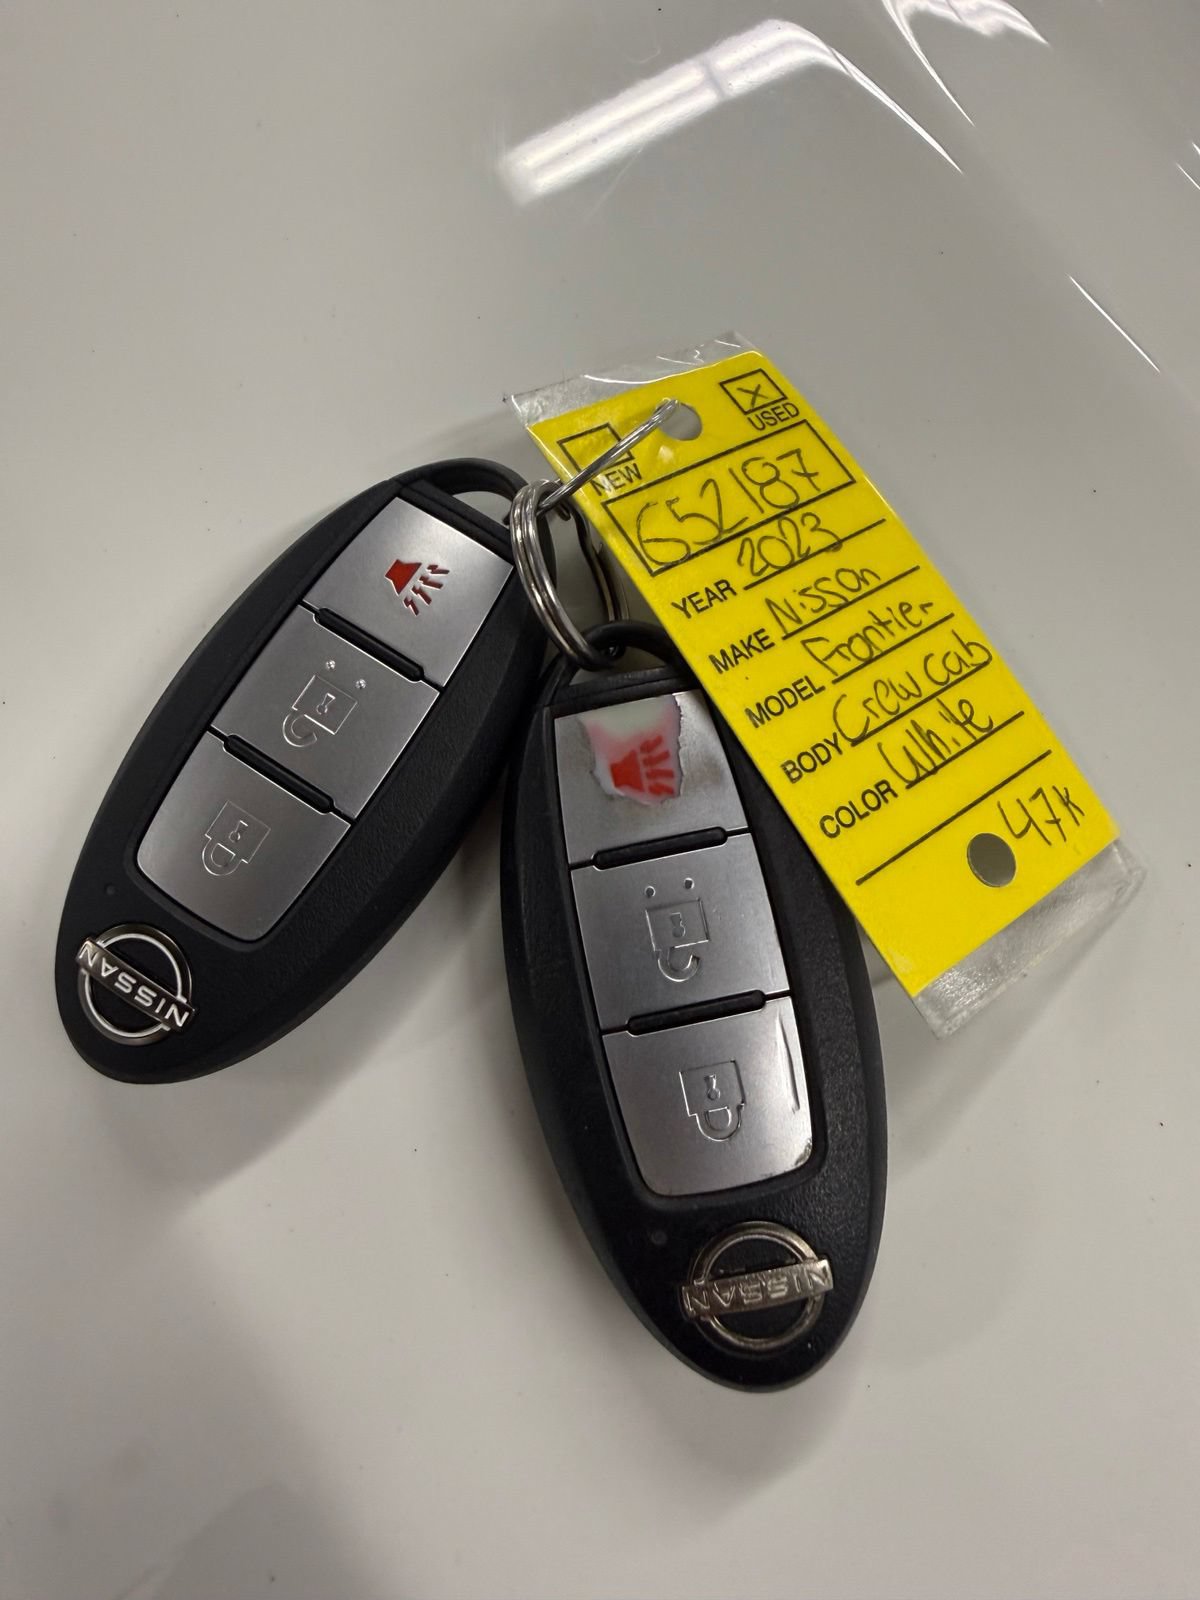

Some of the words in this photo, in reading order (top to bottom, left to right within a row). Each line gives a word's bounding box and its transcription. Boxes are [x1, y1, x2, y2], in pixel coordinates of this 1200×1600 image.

[747, 402, 800, 432] USED
[589, 462, 643, 497] NEW
[636, 448, 821, 567] 652187
[737, 512, 843, 578] 2023
[671, 579, 737, 620] YEAR
[708, 628, 776, 675] MAKE
[745, 674, 826, 729] MODEL
[832, 676, 923, 746] Crew
[780, 733, 844, 784] BODY
[877, 697, 994, 789] White
[818, 779, 899, 840] COLOR
[77, 940, 191, 1028] NISSAN
[682, 1259, 831, 1315] NISSAN
